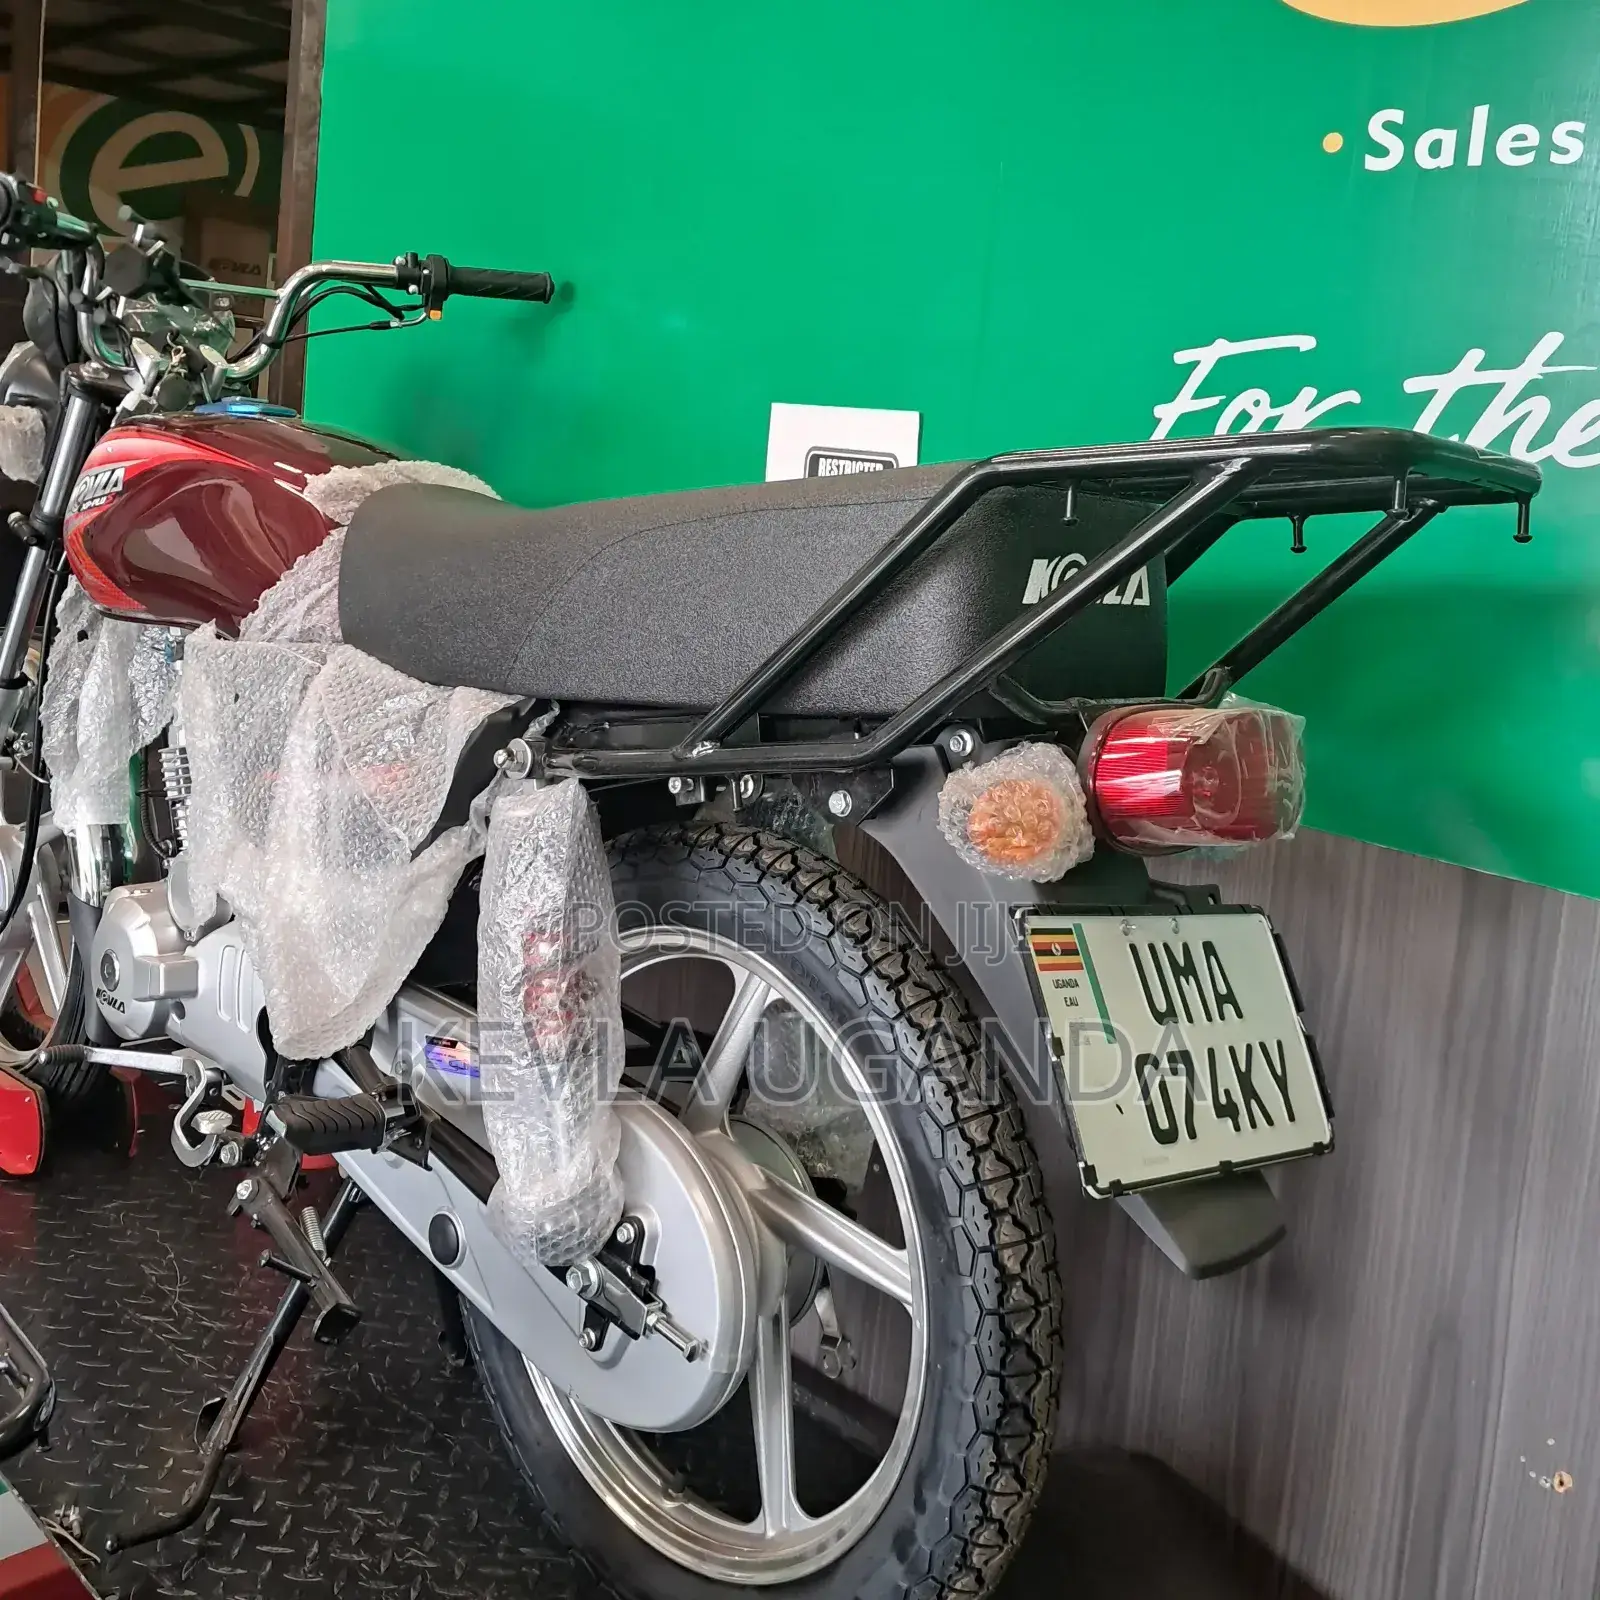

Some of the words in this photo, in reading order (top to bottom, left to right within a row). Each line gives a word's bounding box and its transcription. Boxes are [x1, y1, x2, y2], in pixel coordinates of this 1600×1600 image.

[1363, 104, 1586, 172] Sales
[1149, 334, 1362, 440] For
[1403, 331, 1600, 469] the
[1052, 978, 1080, 990] UGANDA
[1063, 996, 1080, 1008] EAU
[1128, 940, 1244, 1026] UMA
[1134, 1039, 1296, 1145] 074KY
